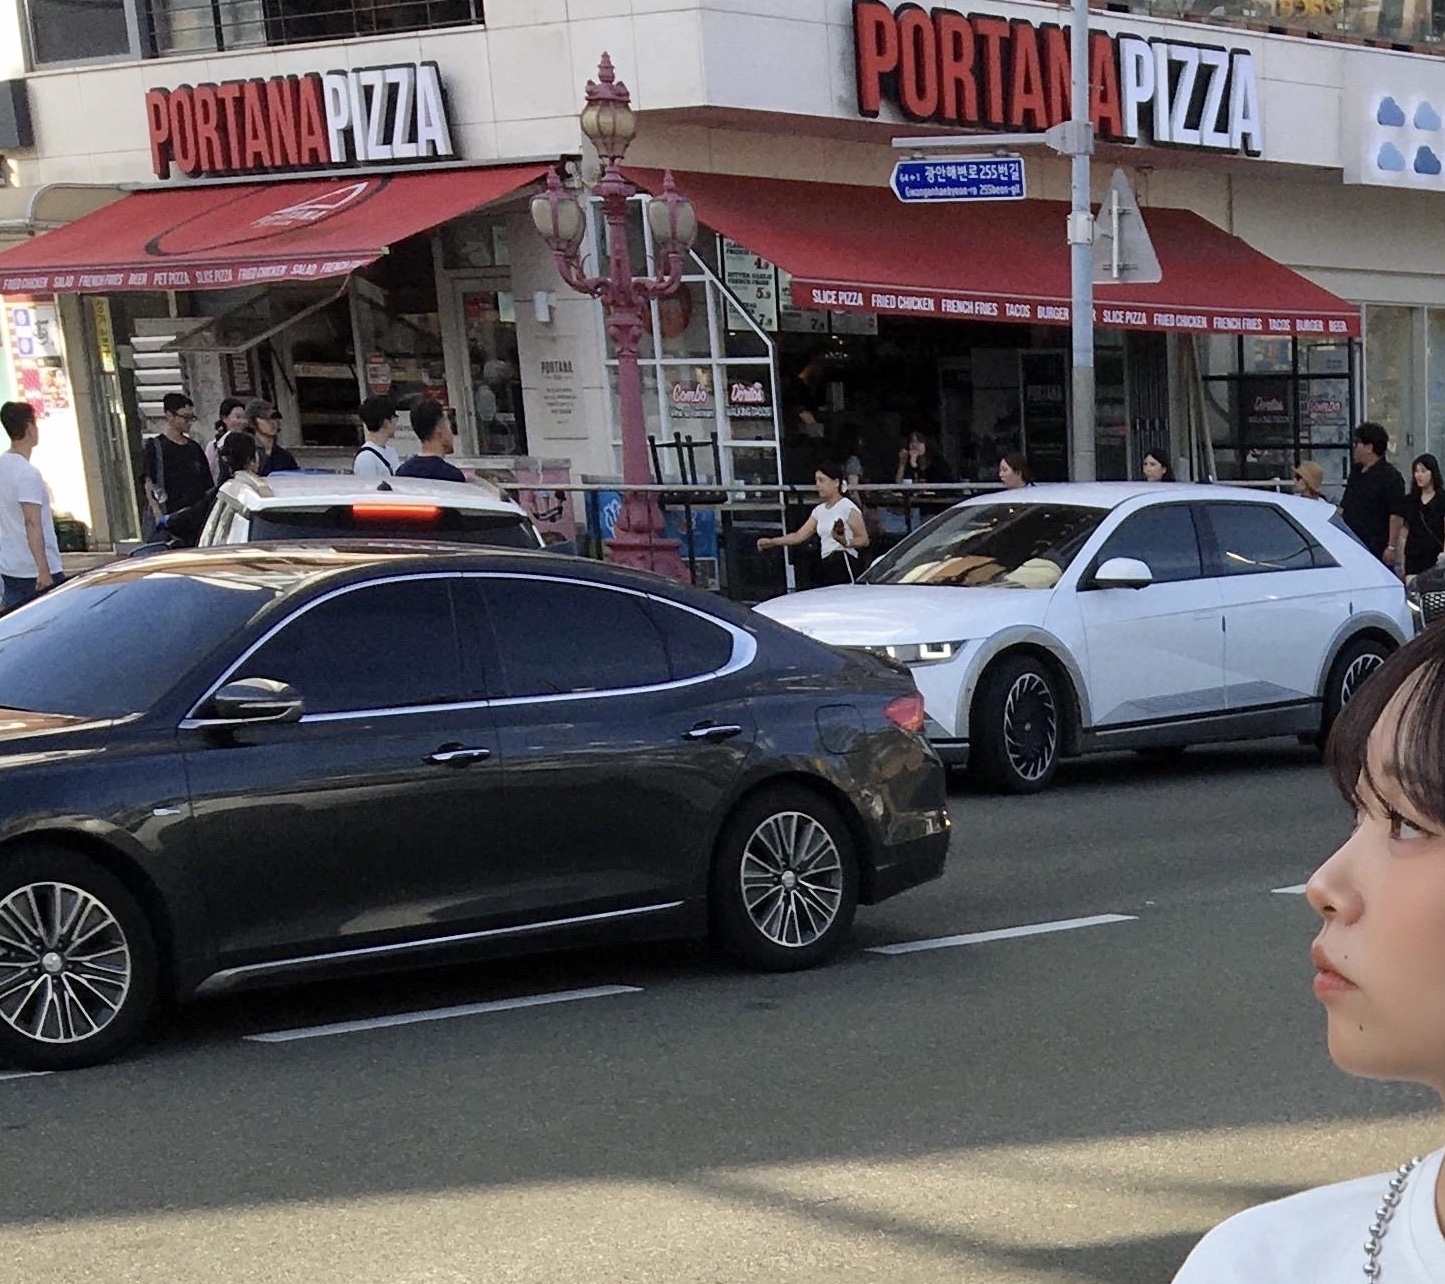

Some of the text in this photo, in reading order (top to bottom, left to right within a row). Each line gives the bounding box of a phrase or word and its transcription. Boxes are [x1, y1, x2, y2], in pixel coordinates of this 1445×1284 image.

[145, 64, 453, 176] PORTANA PIZZA
[1118, 35, 1262, 154] PIZZA
[925, 163, 1020, 183] 광안해변로255번길
[812, 289, 838, 305] SLICE
[838, 291, 864, 307] PIZZA
[871, 293, 896, 309] FRIED
[897, 295, 934, 311] CHICKEN
[941, 299, 974, 315] FRENCH
[974, 301, 998, 317] FRIES
[1005, 303, 1031, 318] TACOS
[1037, 305, 1069, 321] BURGER
[1102, 309, 1125, 324] SLICE
[1125, 310, 1147, 326] PIZZA
[1153, 312, 1176, 327] FRIED
[1176, 314, 1208, 329] CHICKEN
[1213, 316, 1242, 331] FRENCH
[1243, 317, 1263, 331] FRIES
[1268, 318, 1291, 332] TACOS
[1296, 319, 1325, 333] BURGER
[1328, 320, 1348, 333] BEER
